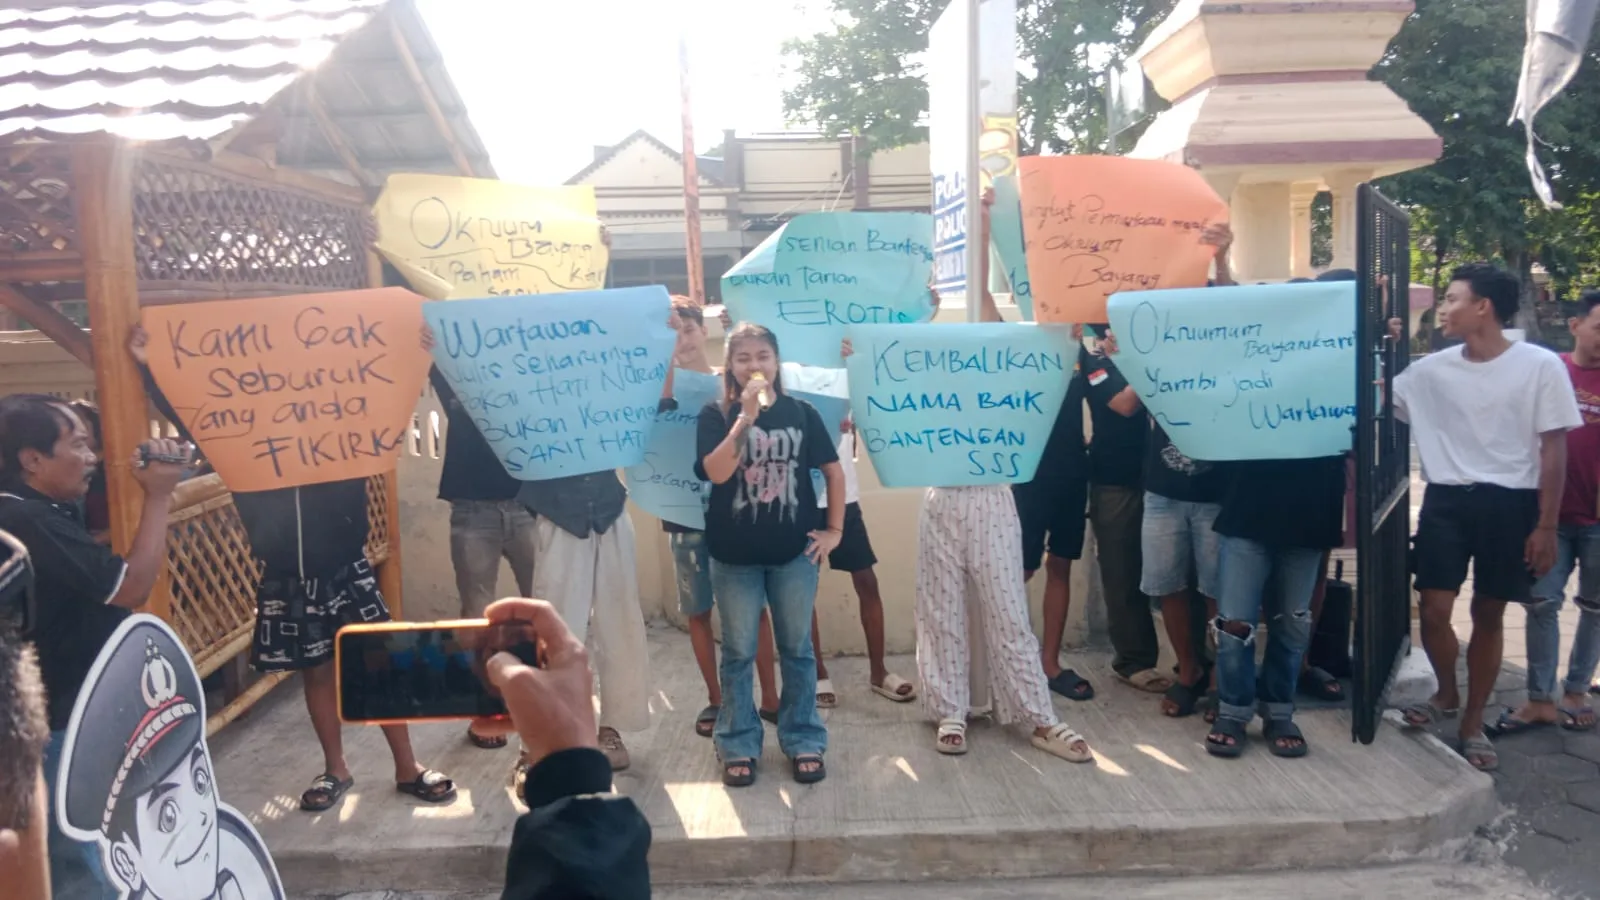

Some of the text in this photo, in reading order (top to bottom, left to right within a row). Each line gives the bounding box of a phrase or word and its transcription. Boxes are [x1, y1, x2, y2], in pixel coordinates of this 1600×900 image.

[439, 317, 608, 360] Wartawan
[872, 340, 1064, 386] KEMBALIKAN
[272, 391, 368, 424] anda
[867, 391, 962, 417] NAMA
[504, 438, 586, 472] SAKIT
[864, 426, 1026, 453] BANTENGAN
[968, 450, 1022, 478] SSS
